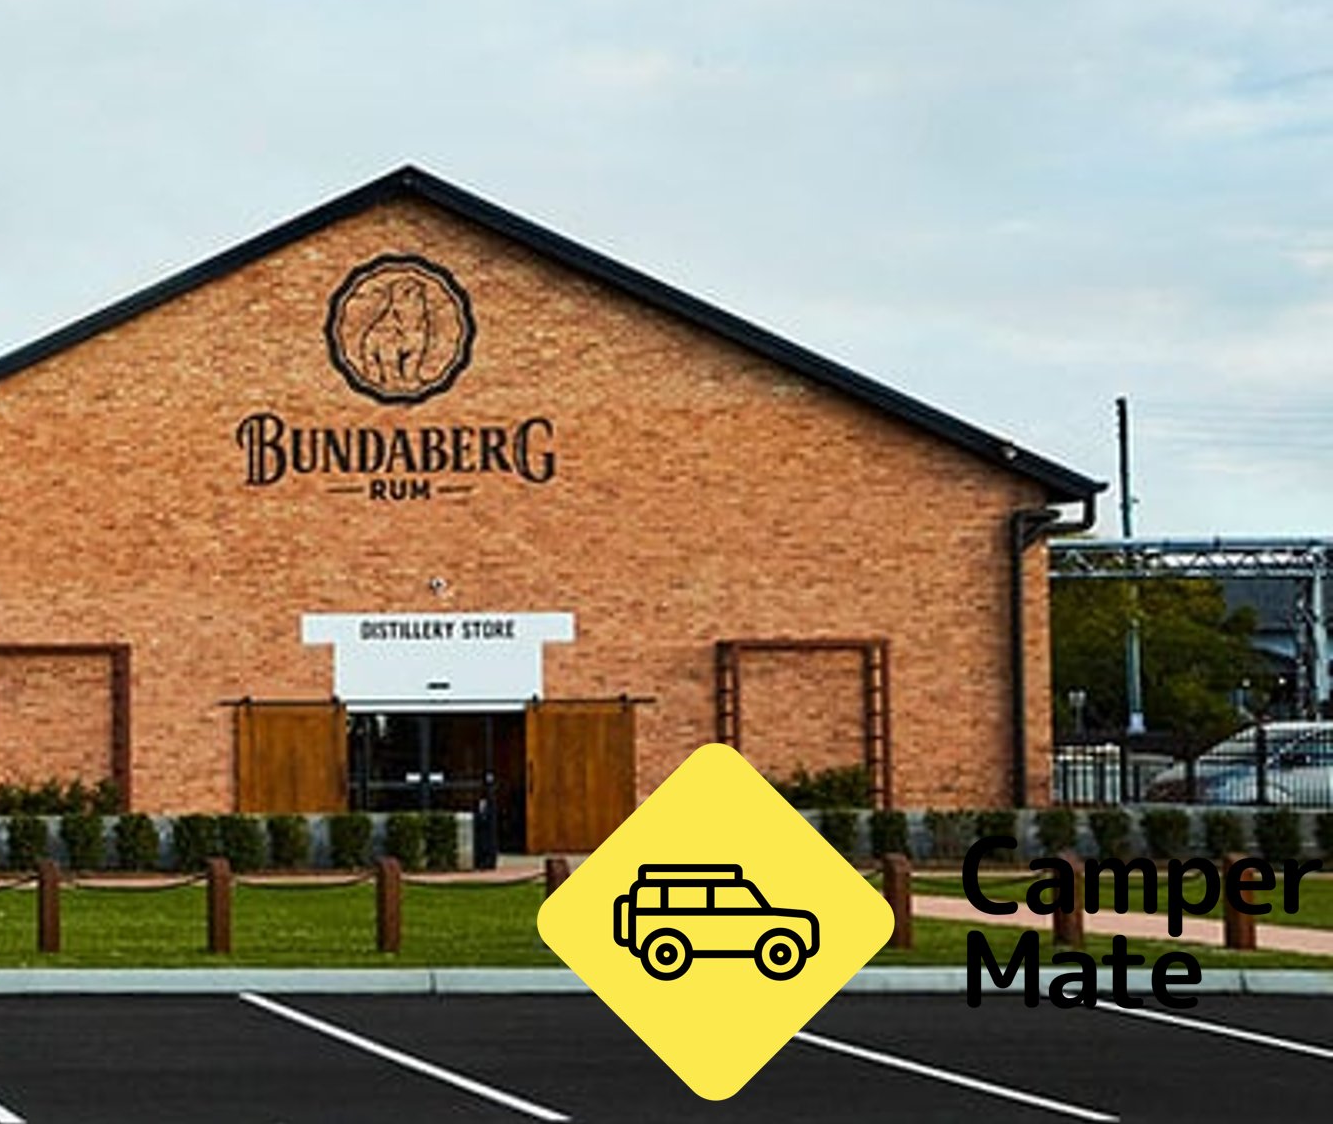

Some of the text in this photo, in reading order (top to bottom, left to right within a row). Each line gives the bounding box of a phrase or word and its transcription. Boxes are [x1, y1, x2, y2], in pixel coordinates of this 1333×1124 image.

[236, 412, 555, 485] BUNDABERG
[369, 478, 431, 501] RUM
[360, 620, 515, 640] DISTILLERY STORE
